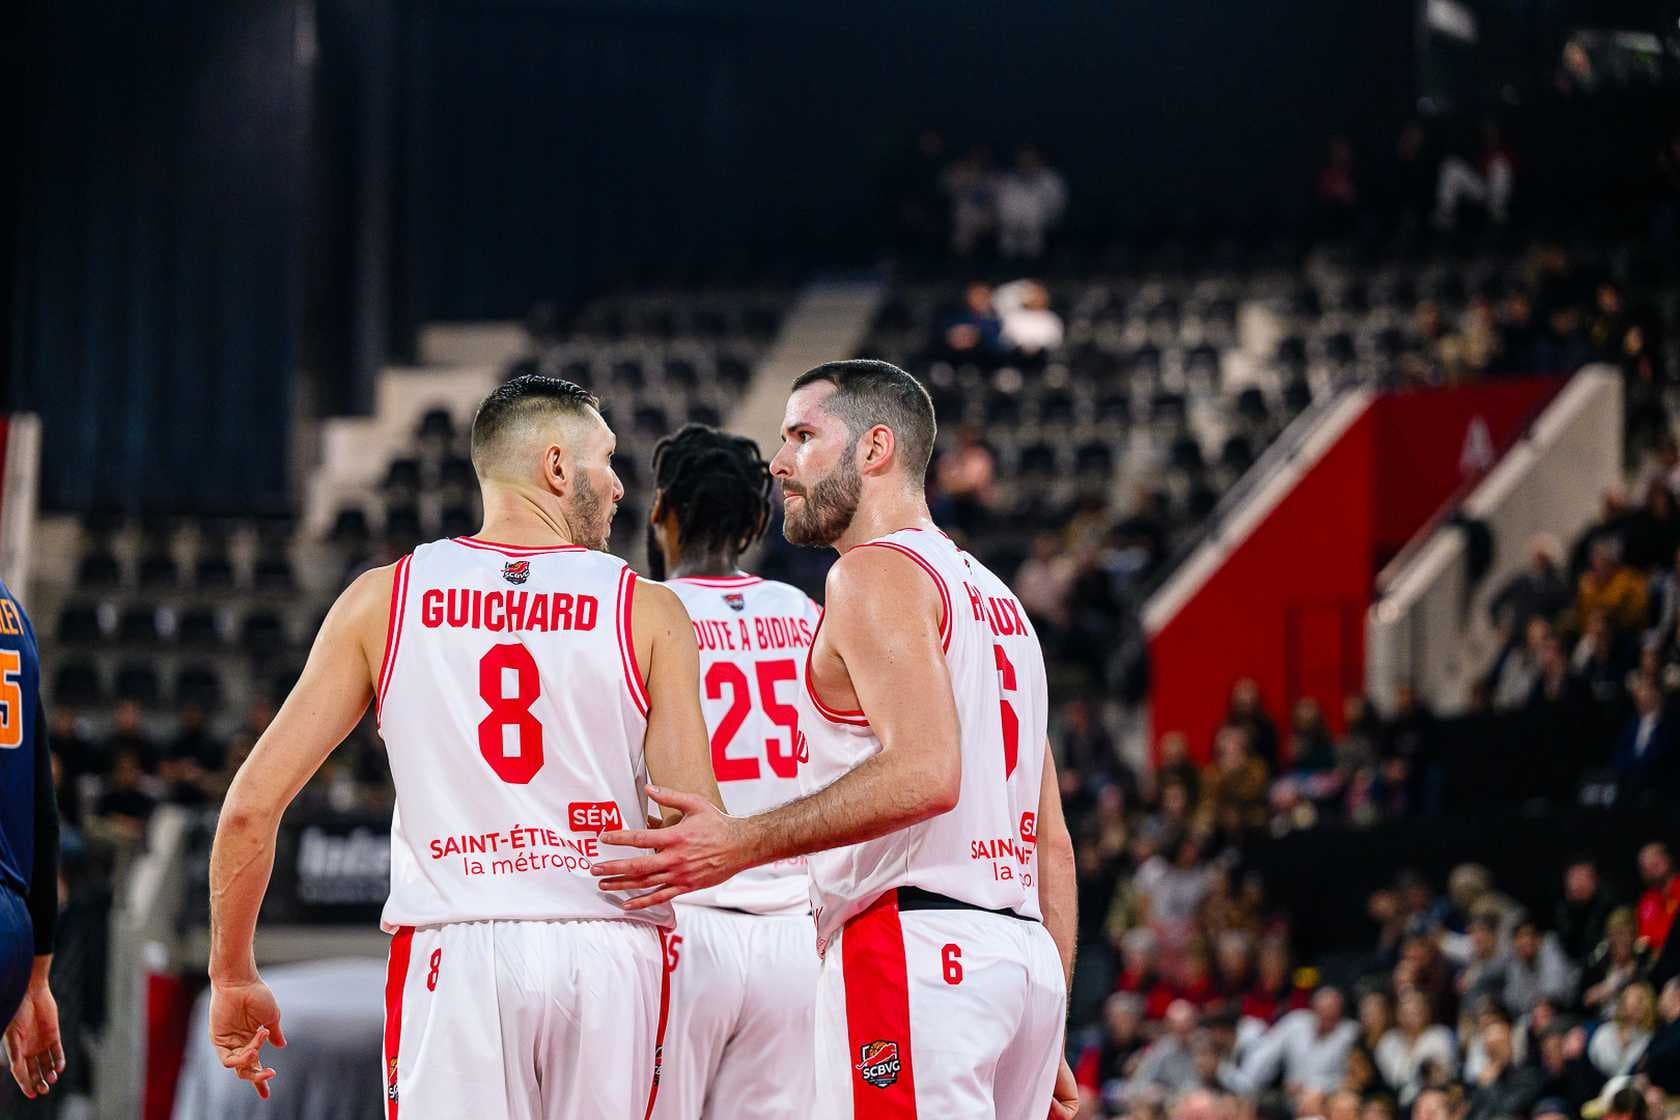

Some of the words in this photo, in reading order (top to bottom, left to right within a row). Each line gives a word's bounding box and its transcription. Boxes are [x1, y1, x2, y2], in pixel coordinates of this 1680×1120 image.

[422, 588, 599, 633] GUICHARD
[738, 618, 751, 651] A
[754, 617, 812, 650] BIDIAS
[478, 643, 545, 784] 8
[705, 659, 799, 782] 25
[573, 805, 618, 826] SÉM
[464, 857, 485, 876] la
[993, 861, 1014, 881] la
[427, 947, 442, 992] 8
[941, 943, 963, 985] 6
[863, 1060, 900, 1079] SCBVG
